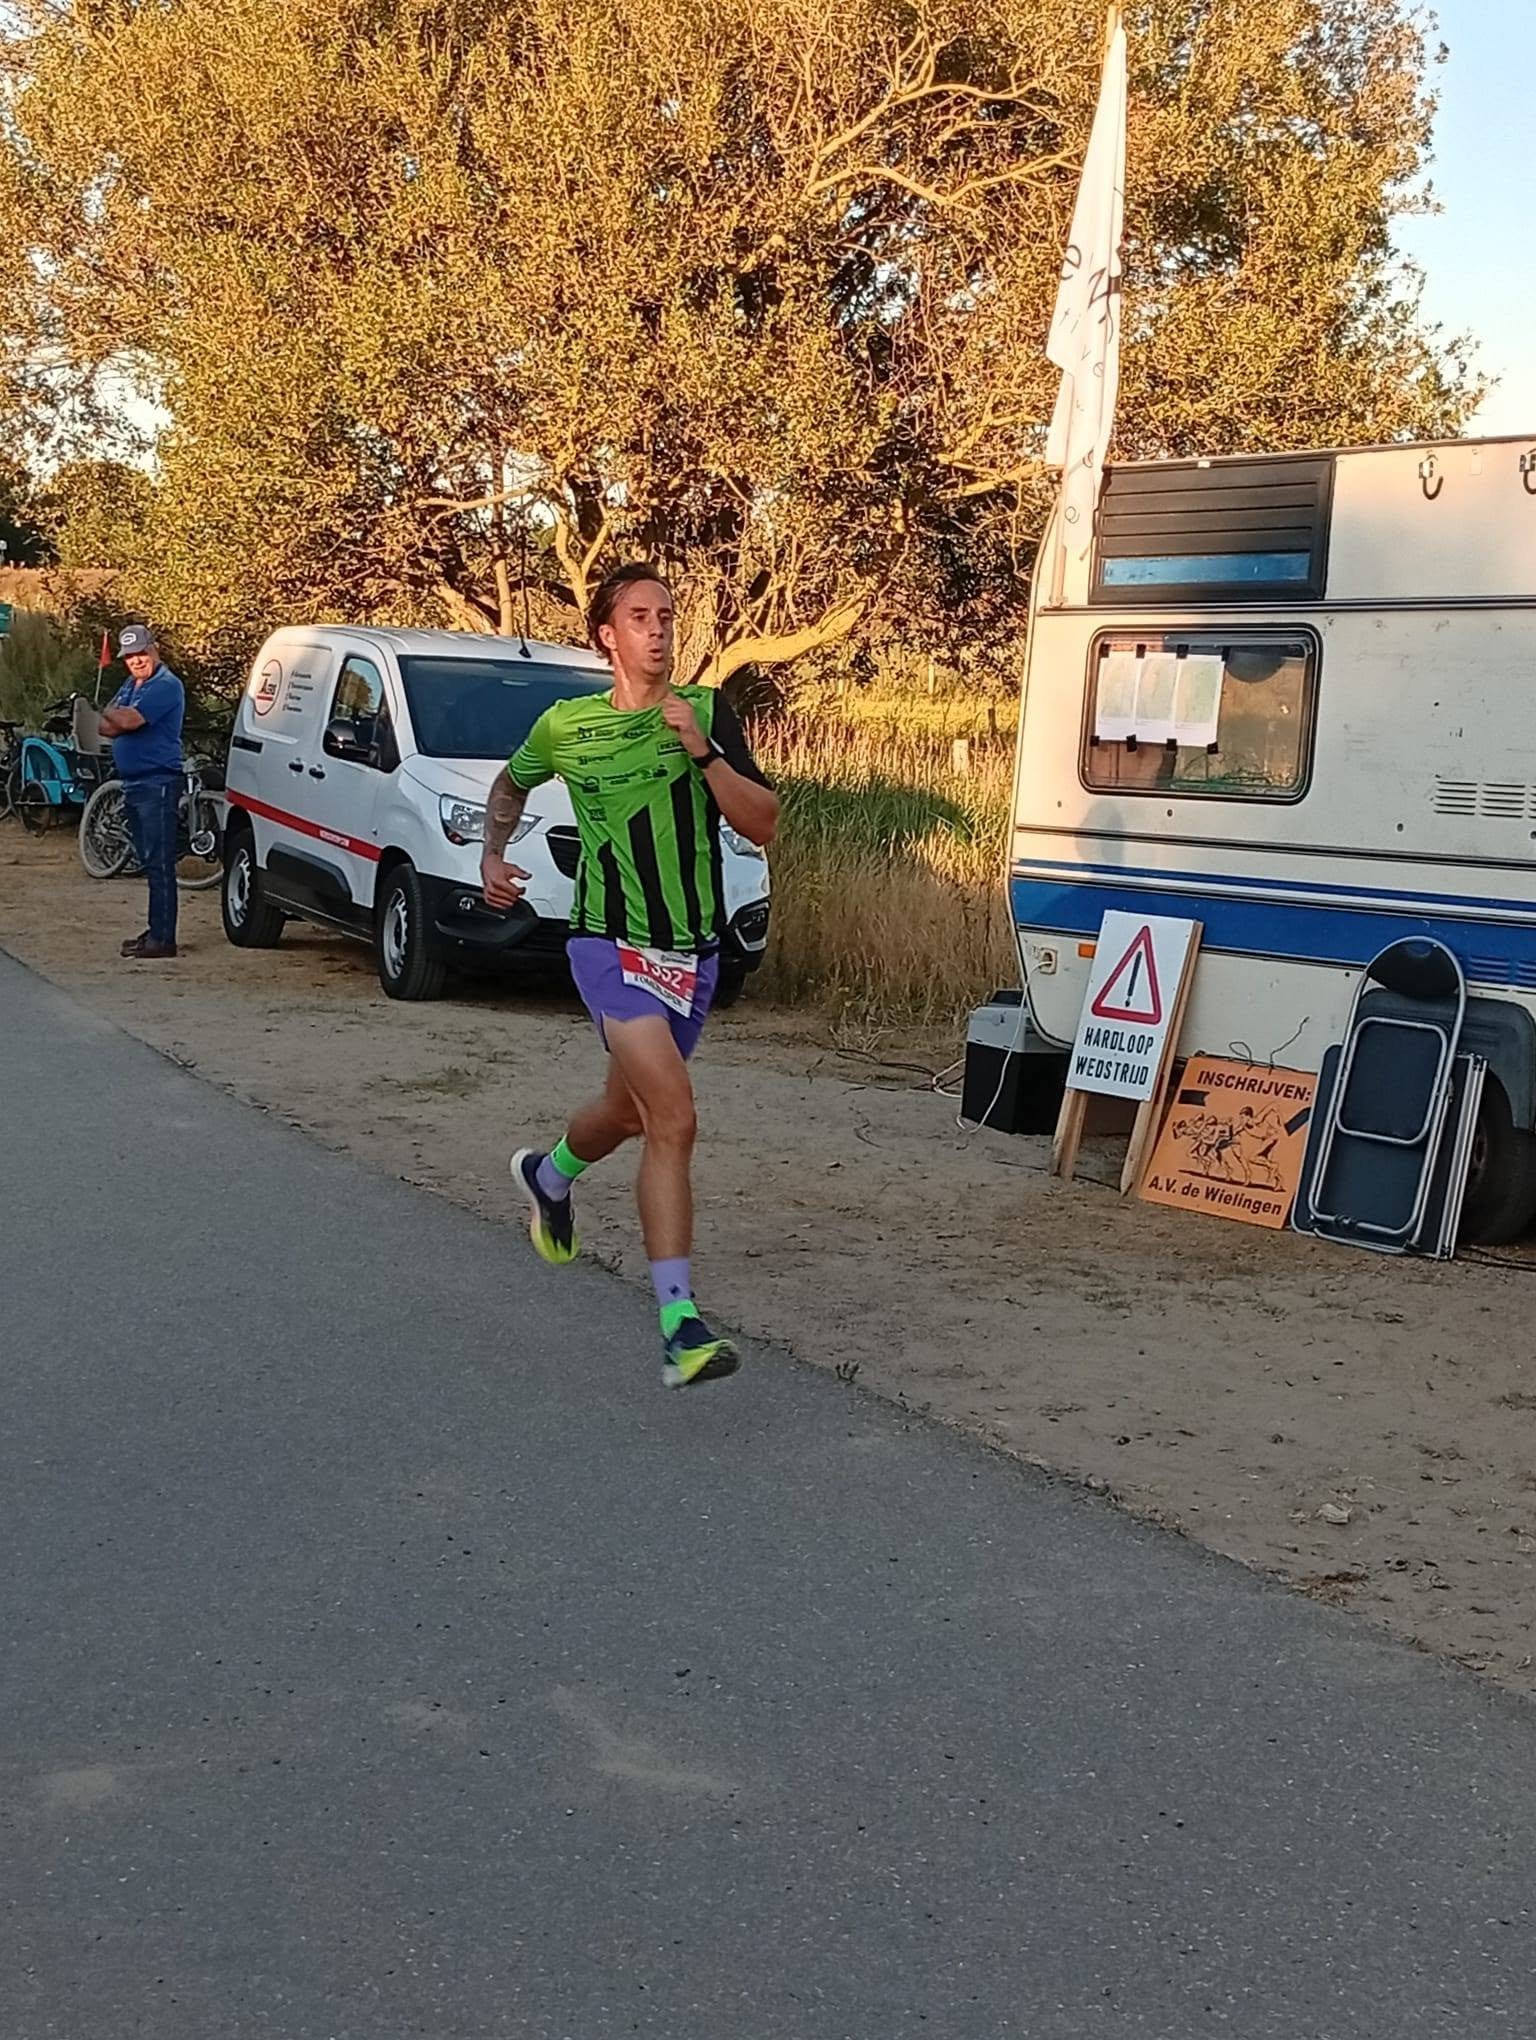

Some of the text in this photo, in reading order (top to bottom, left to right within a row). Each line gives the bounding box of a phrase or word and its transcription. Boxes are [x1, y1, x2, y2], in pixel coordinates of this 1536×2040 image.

[1084, 1026, 1154, 1056] HARDLOOP
[1075, 1055, 1149, 1086] WEDSTRIJD
[1197, 1070, 1312, 1102] INSCHRIJVEN:
[1148, 1175, 1282, 1216] A.V. de Wielingen
